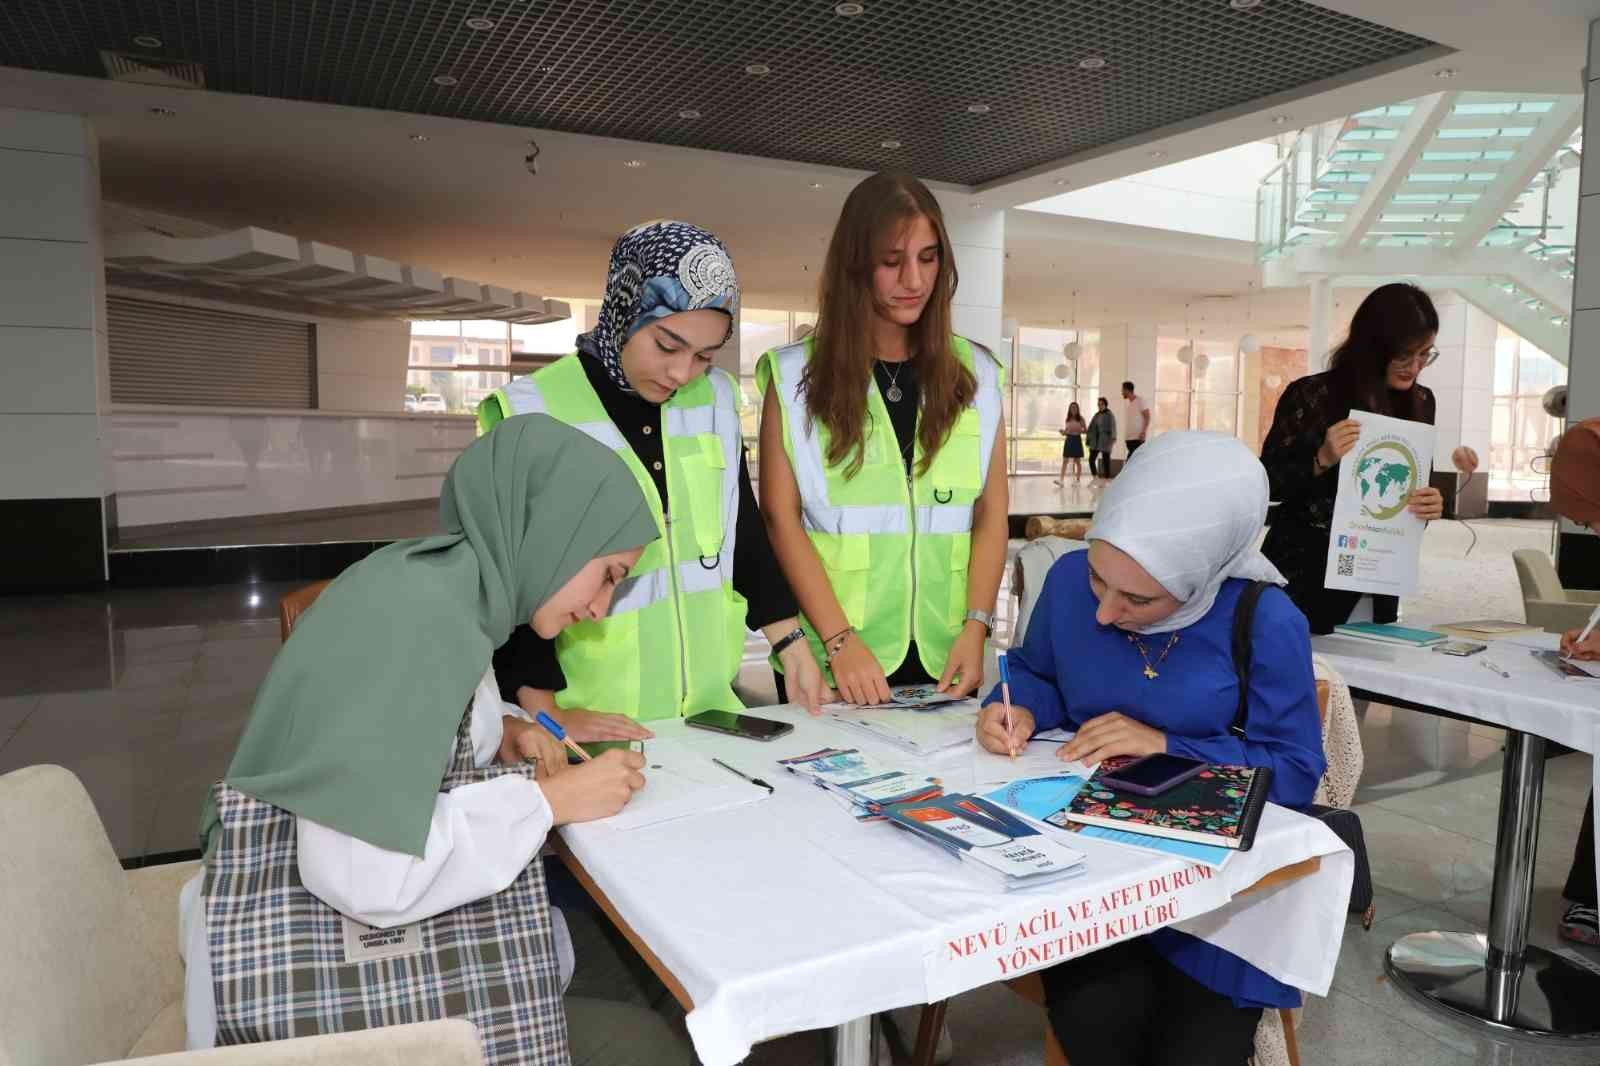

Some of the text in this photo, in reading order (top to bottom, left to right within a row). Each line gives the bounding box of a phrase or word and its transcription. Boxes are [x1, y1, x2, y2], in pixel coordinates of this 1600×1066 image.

[948, 863, 1213, 961] NEVÜ ACİL VE AFET DURUM
[997, 896, 1179, 974] YÖNETİMİ KULÜBÜ
